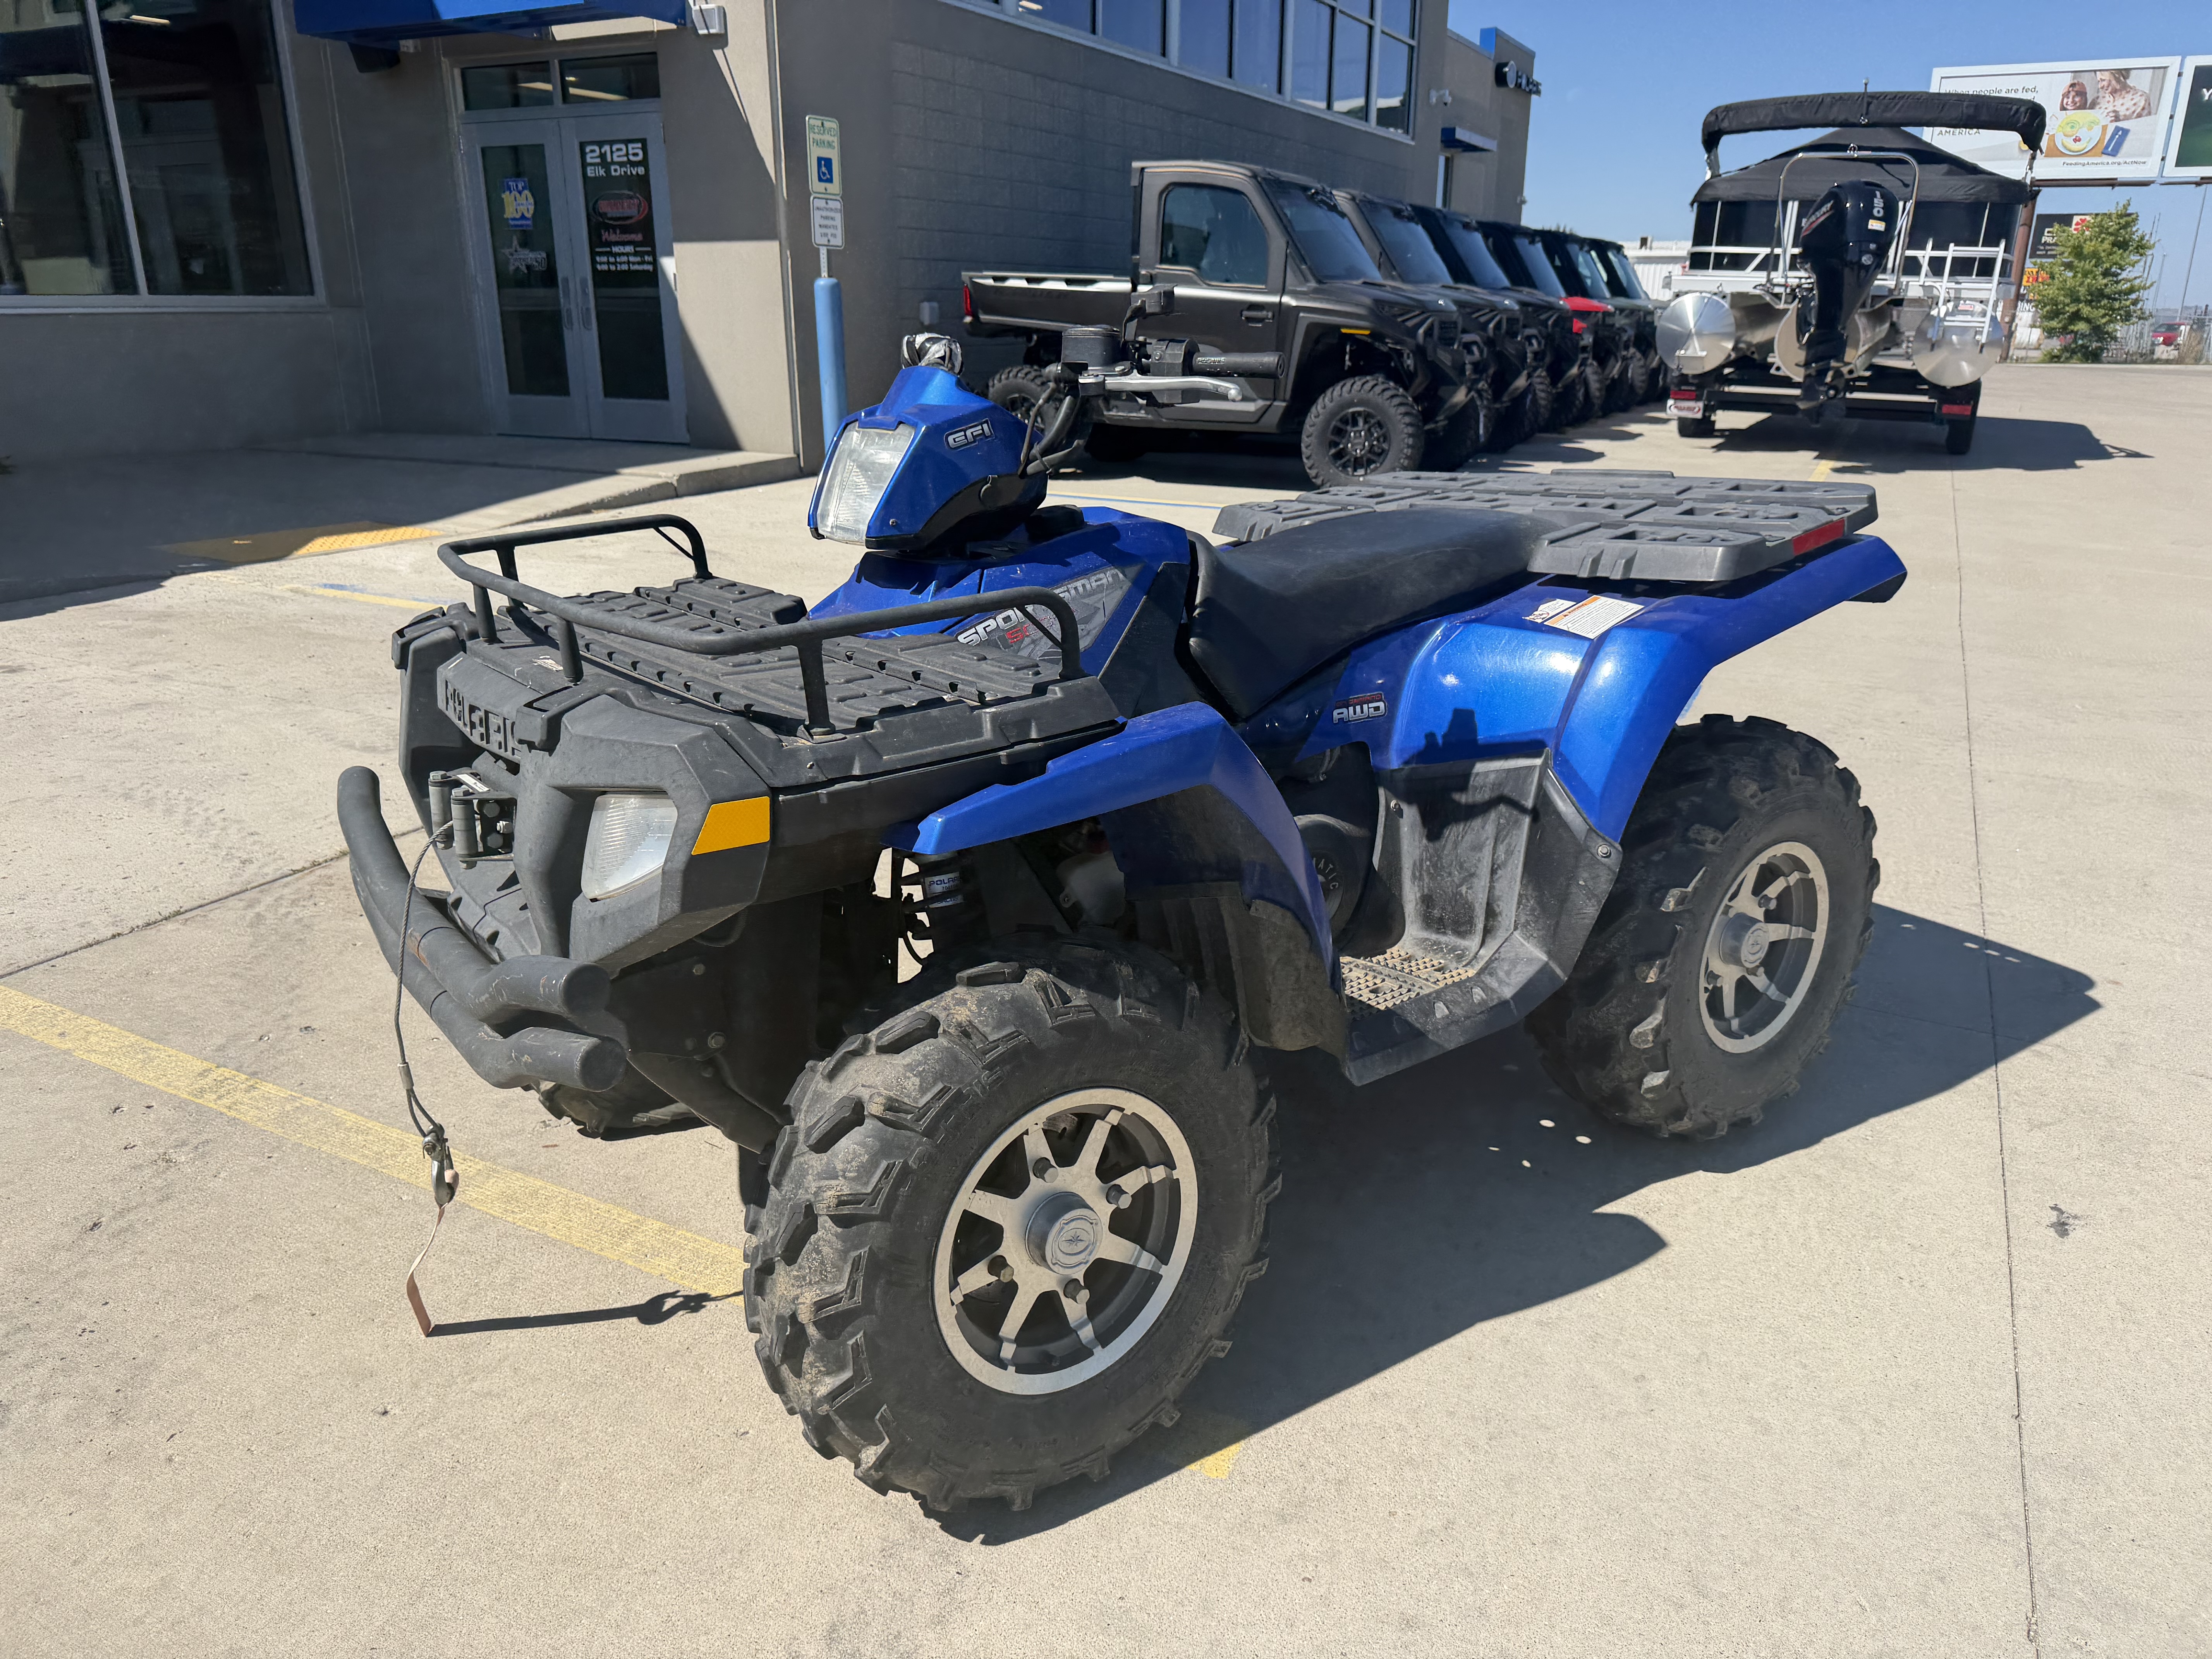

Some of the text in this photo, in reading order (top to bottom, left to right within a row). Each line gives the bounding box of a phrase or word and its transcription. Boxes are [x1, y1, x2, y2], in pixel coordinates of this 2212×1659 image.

[2021, 85, 2039, 94] fed,
[810, 124, 837, 137] RESERVED
[812, 137, 836, 150] PARKING
[586, 143, 643, 163] 2125
[587, 164, 646, 177] Elk Drive
[508, 181, 524, 191] TOP
[501, 190, 534, 218] 100
[1873, 191, 1884, 217] 150
[948, 423, 991, 448] EFI
[1333, 701, 1385, 723] AWD
